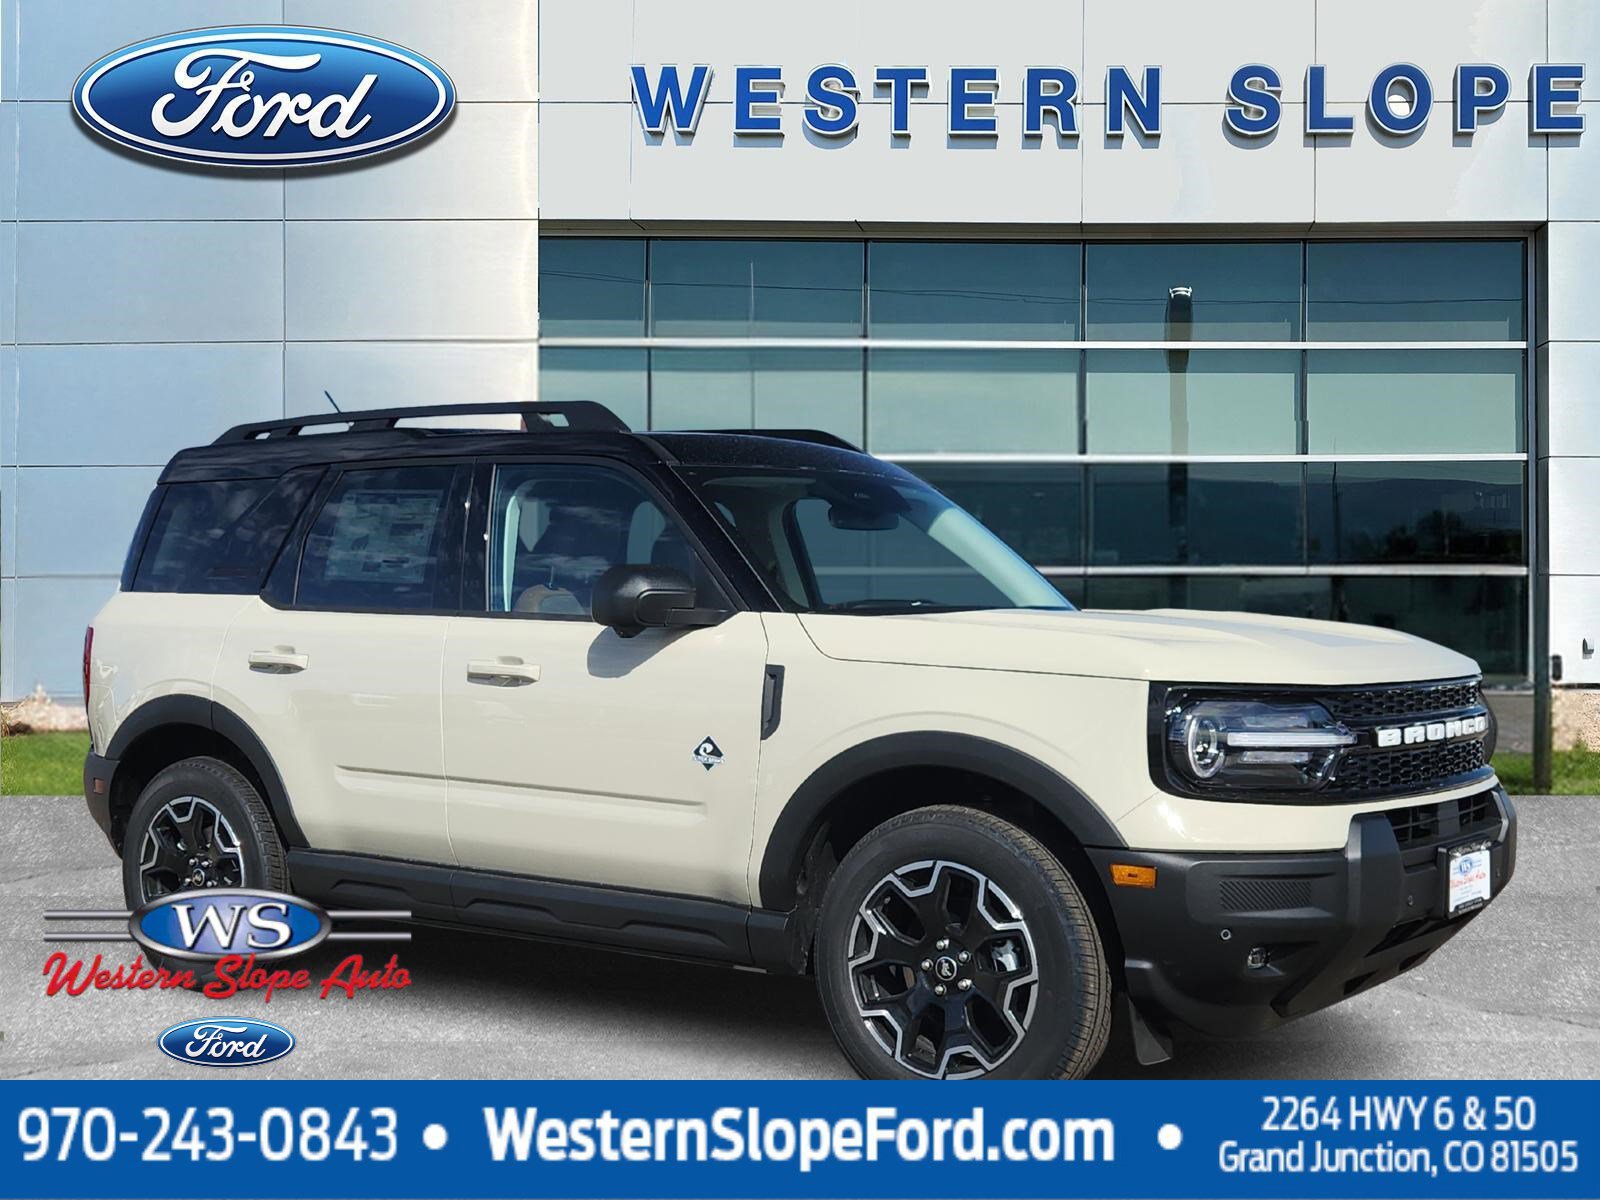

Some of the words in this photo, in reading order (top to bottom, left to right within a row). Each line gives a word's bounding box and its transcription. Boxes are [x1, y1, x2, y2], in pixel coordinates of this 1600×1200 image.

[150, 48, 378, 138] Ford
[630, 64, 1163, 136] WESTERN
[1225, 63, 1586, 135] SLOPE
[1377, 715, 1486, 747] BRONCO
